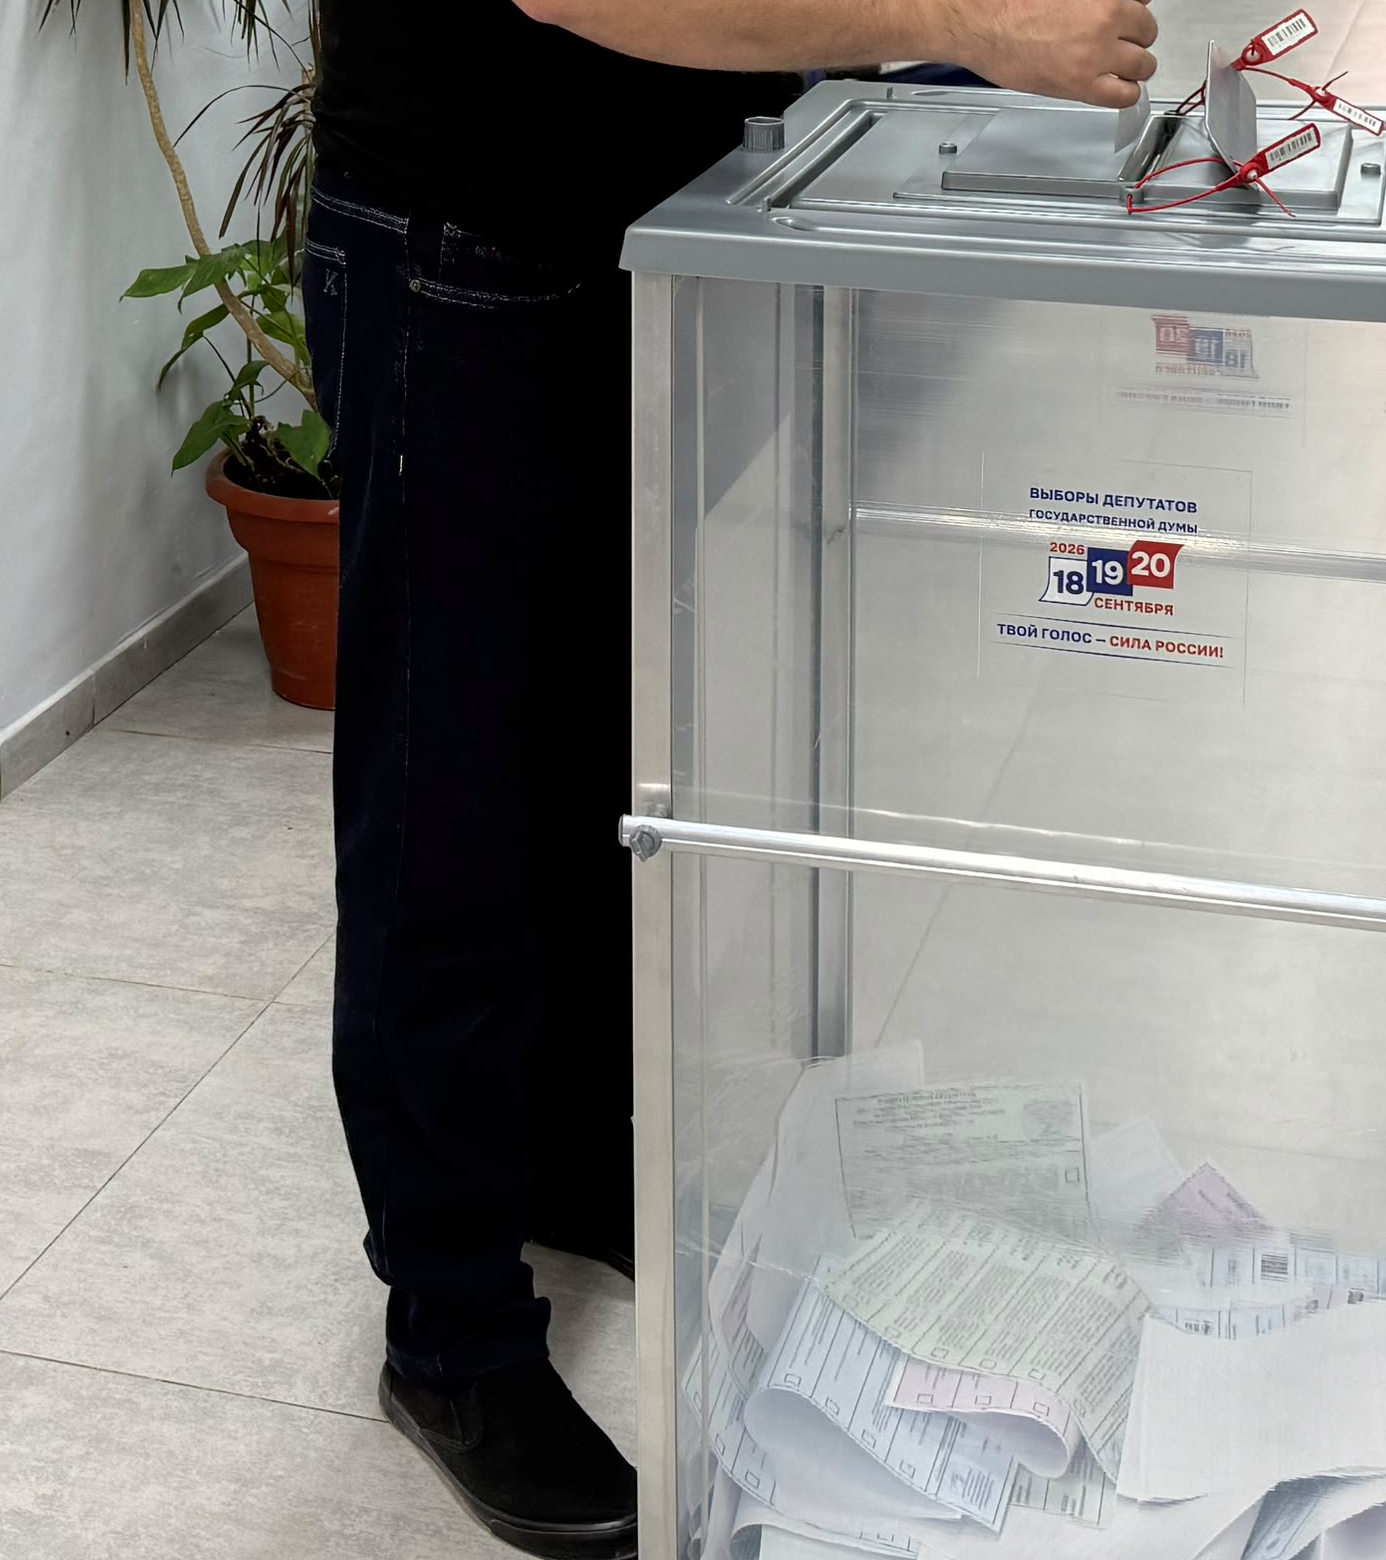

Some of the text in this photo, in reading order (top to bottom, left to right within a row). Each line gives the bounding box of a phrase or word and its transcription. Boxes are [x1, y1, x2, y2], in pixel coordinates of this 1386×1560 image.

[1029, 487, 1198, 514] ВЫБОРЫ ДЕПУТАТОВ
[1028, 509, 1198, 534] ГОСУДАРСТВЕННОЙ ДУМЫ
[1049, 542, 1085, 556] 2026
[1053, 551, 1171, 595] 18 19 20
[1094, 597, 1174, 616] СЕНТЯБРЯ
[997, 623, 1038, 639] ТВОЙ
[1041, 628, 1093, 644] ГОЛОС
[1109, 635, 1152, 651] СИЛА
[1155, 640, 1224, 658] РОССИИ!
